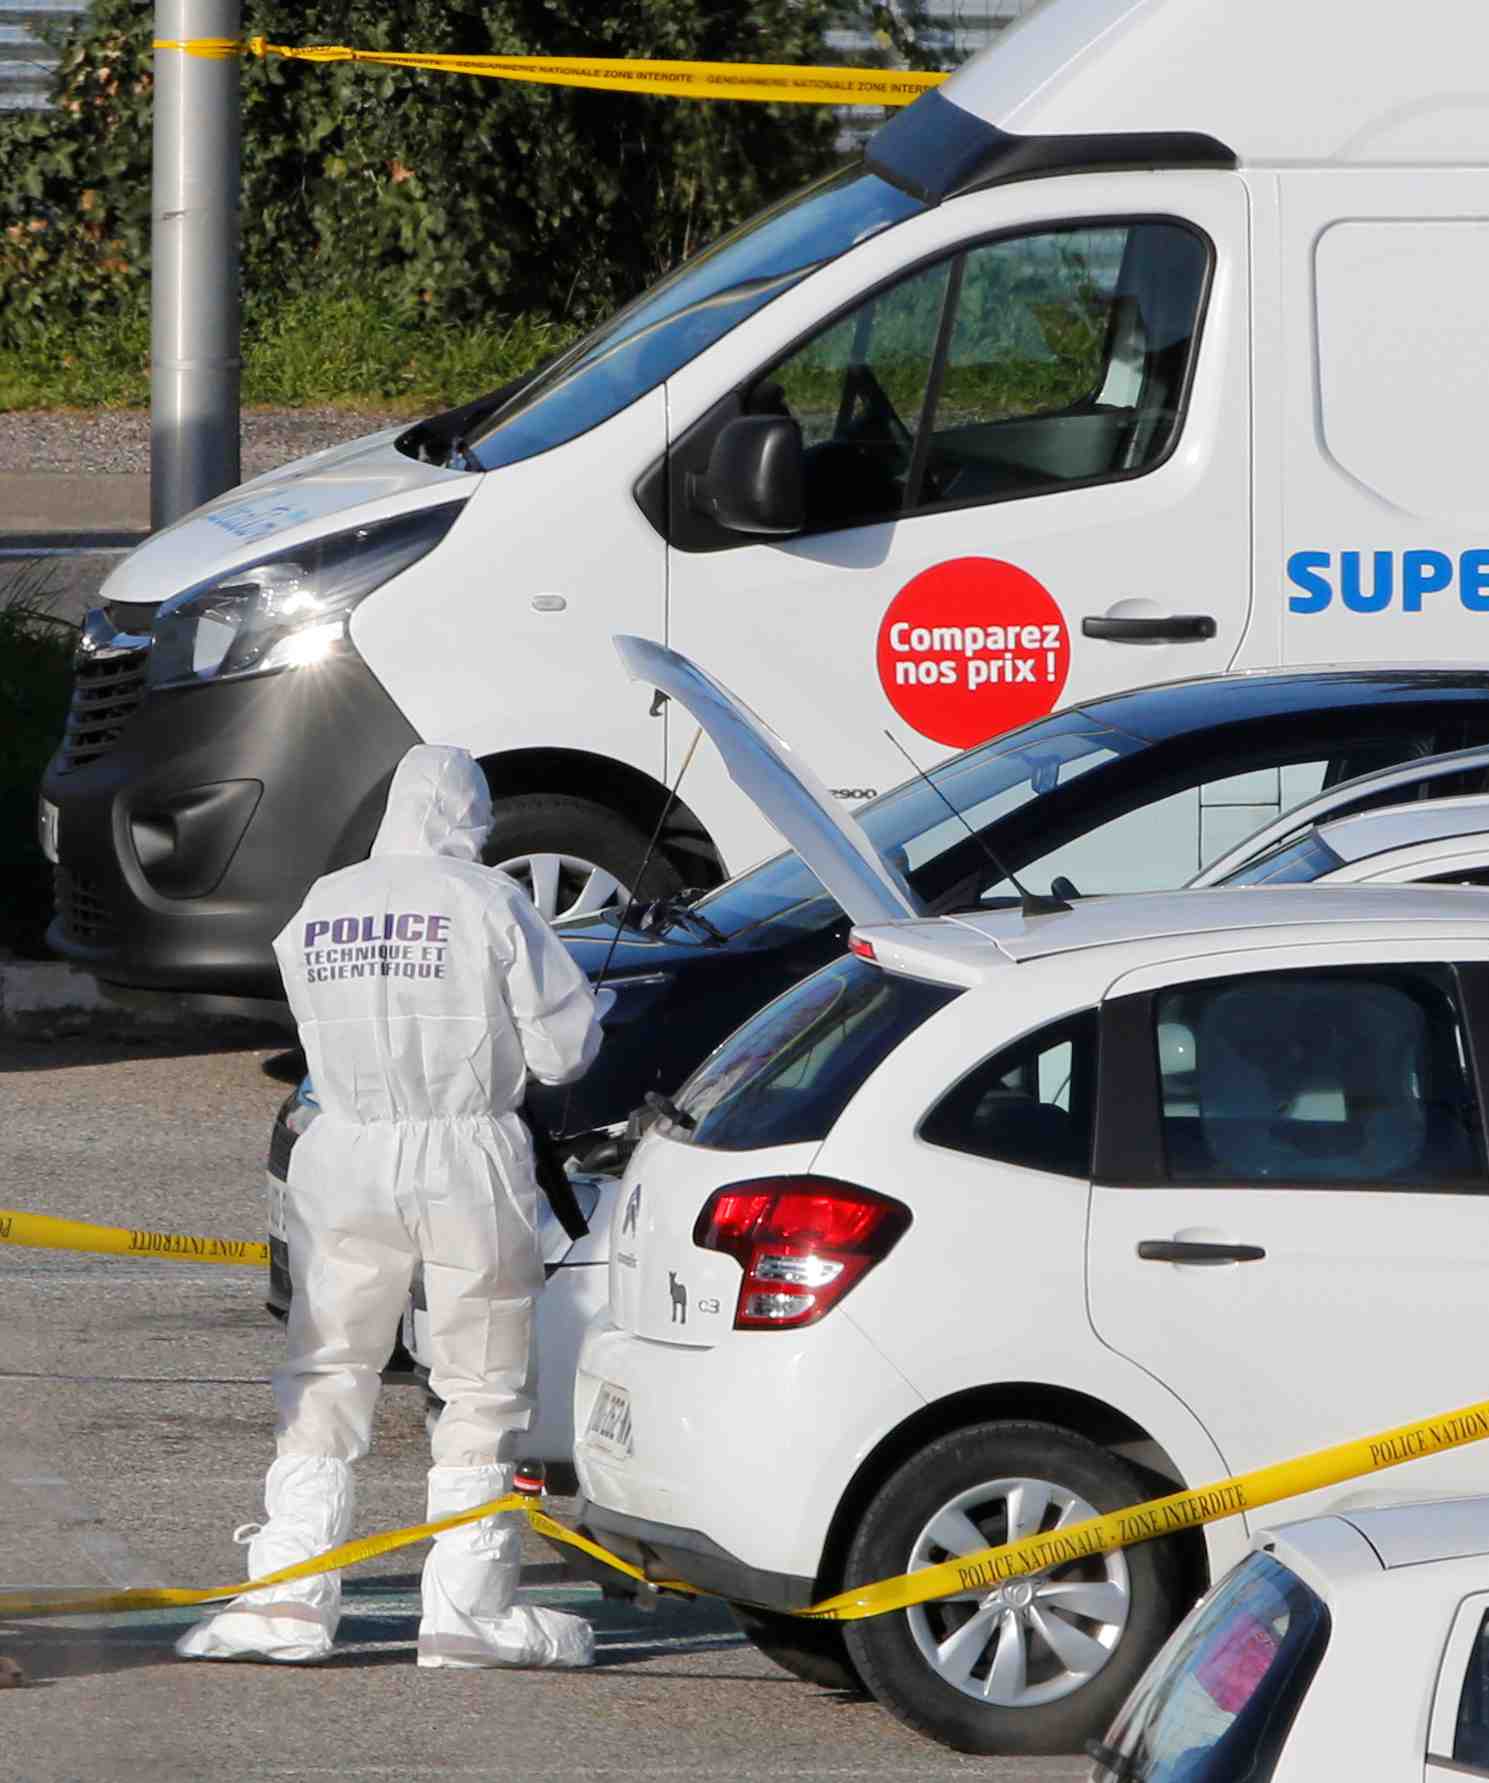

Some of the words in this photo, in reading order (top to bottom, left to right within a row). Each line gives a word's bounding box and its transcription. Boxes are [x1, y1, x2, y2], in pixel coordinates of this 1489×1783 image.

[604, 69, 633, 80] ZONE
[635, 71, 694, 83] INTERDITE
[857, 81, 887, 93] ZONE
[889, 621, 1061, 657] Comparez
[895, 660, 958, 685] nos
[967, 652, 1036, 690] prix
[303, 913, 451, 948] POLICE
[304, 944, 413, 967] TECHNIQUE
[421, 946, 448, 962] ET
[1368, 1429, 1432, 1466] POLICE
[957, 1554, 1015, 1590] POLICE
[1019, 1527, 1106, 1573] NATIONALE
[1118, 1510, 1161, 1542] ZONE
[1161, 1484, 1248, 1529] INTERDITE
